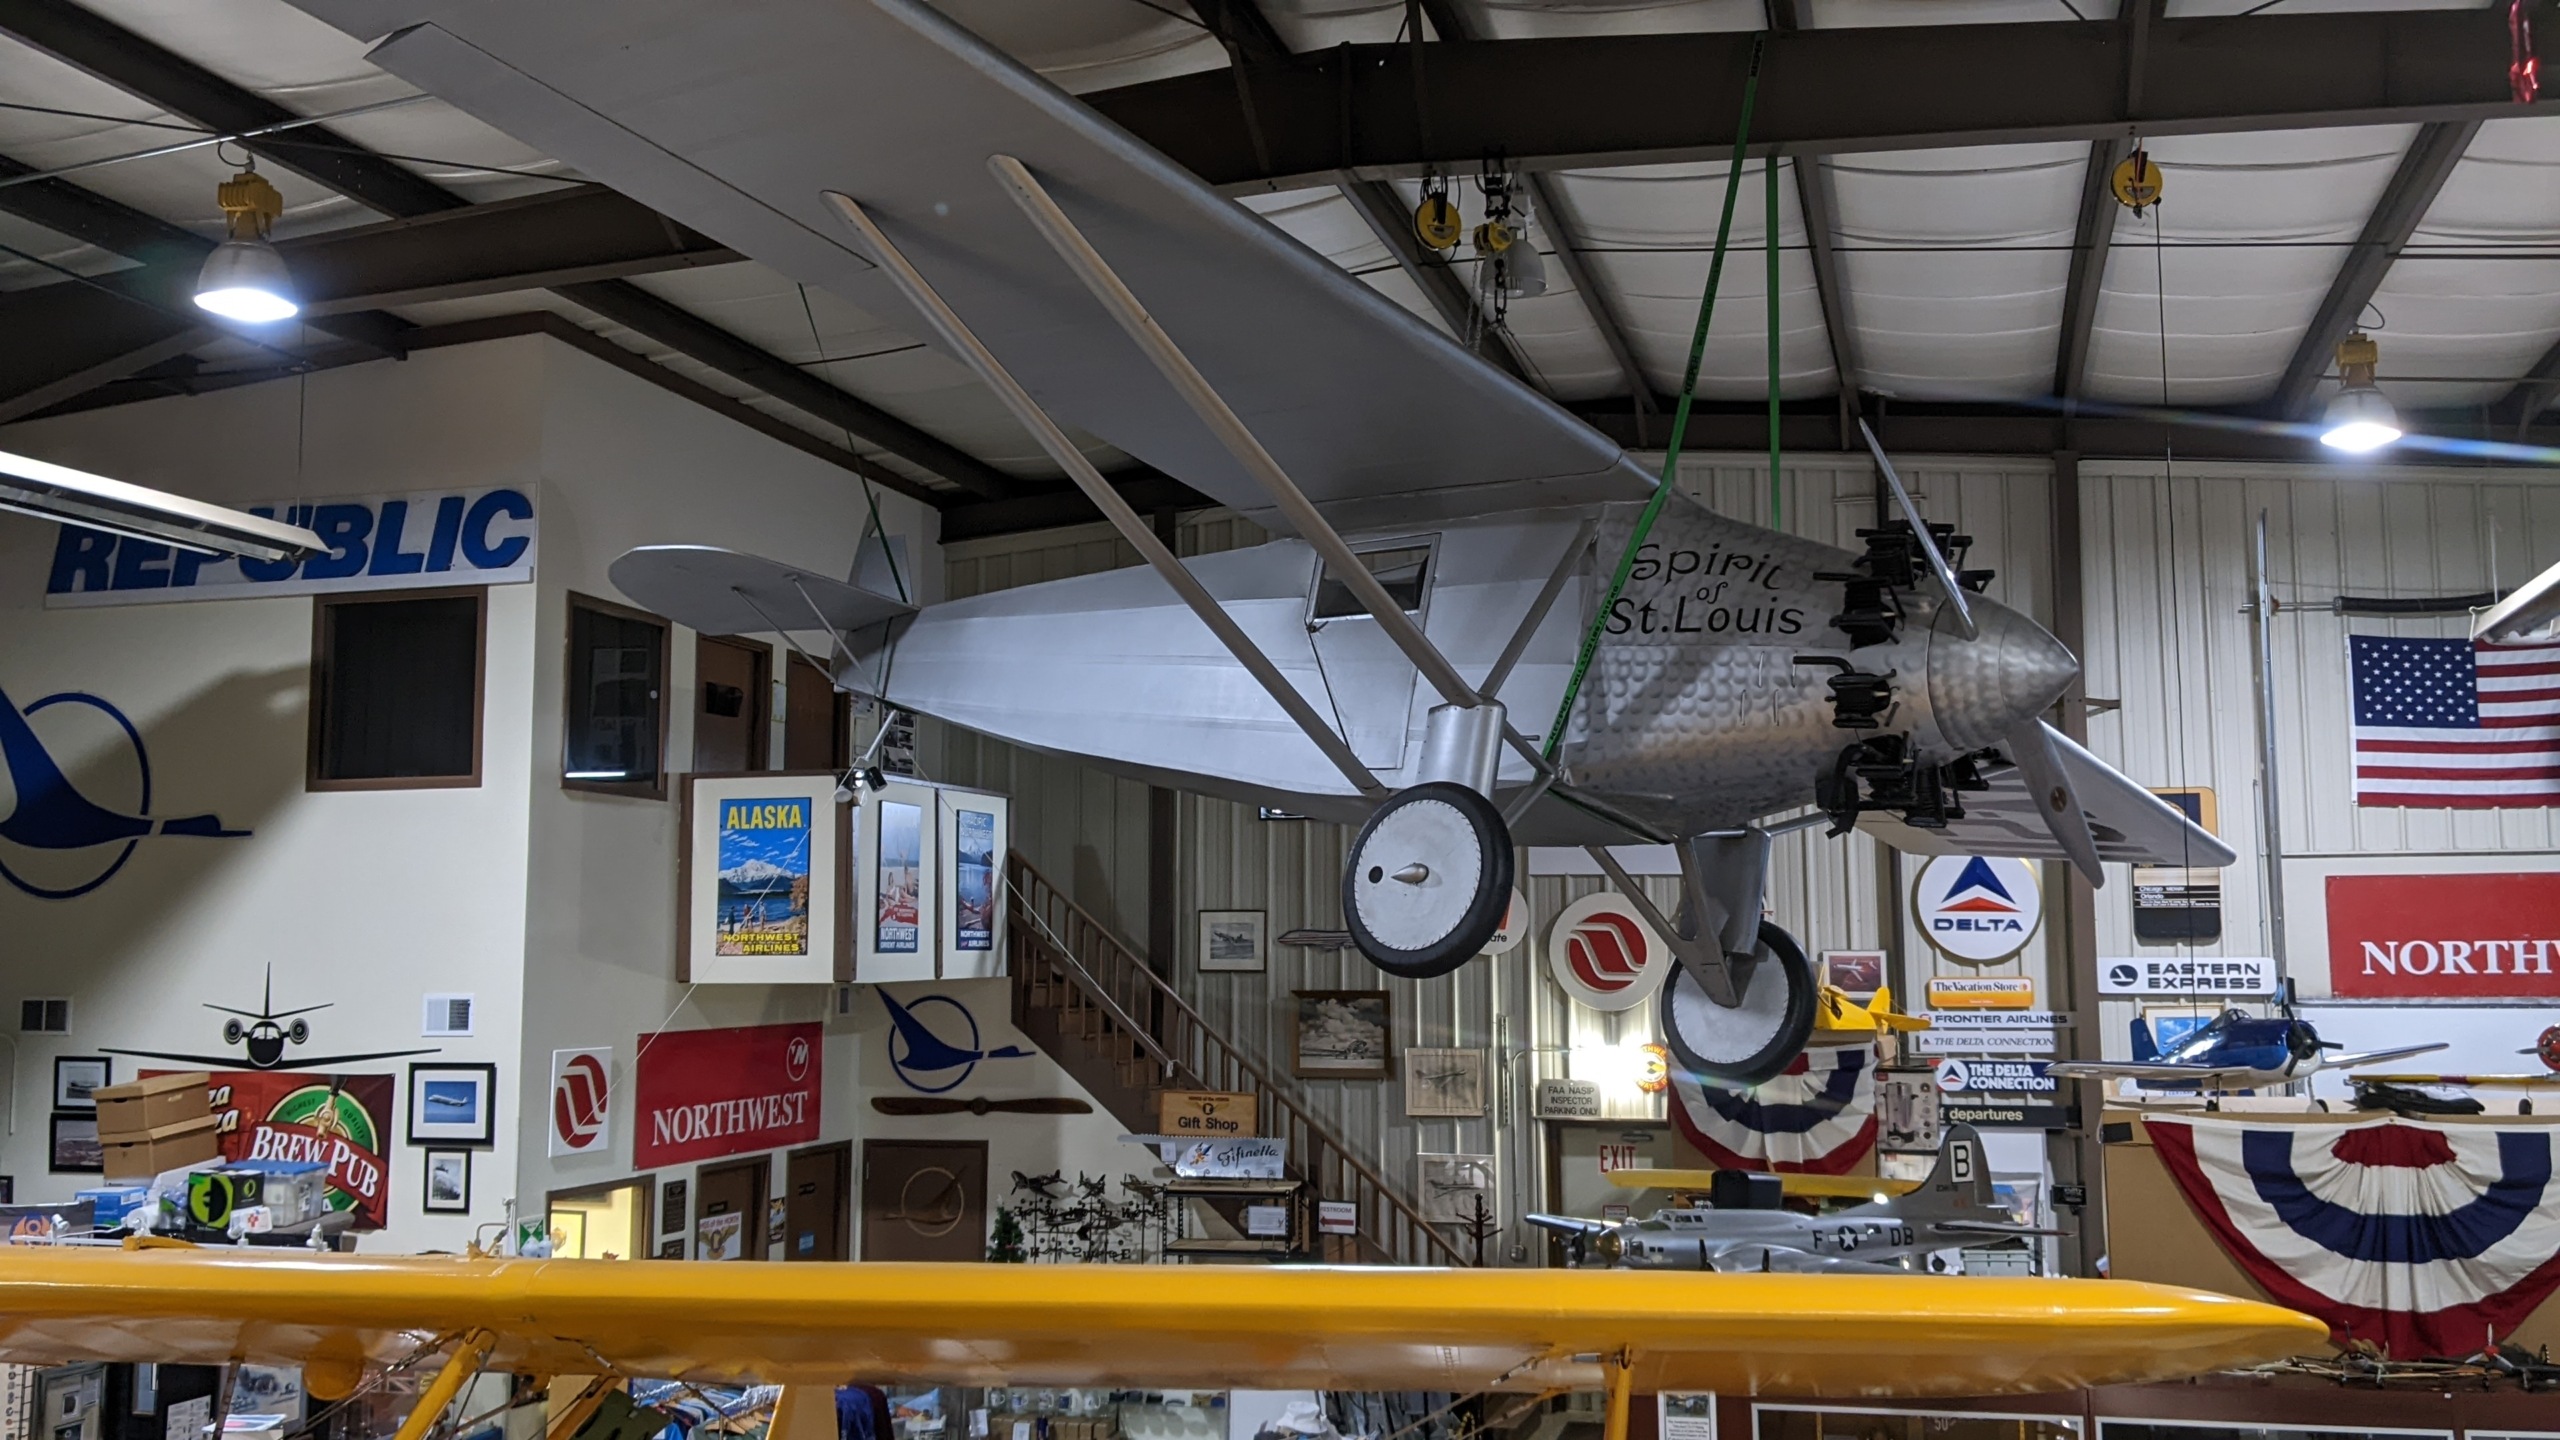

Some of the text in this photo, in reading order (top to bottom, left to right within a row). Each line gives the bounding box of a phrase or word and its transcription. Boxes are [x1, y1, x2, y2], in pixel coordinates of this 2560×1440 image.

[1630, 542, 1784, 590] Spirit
[1696, 581, 1728, 604] of
[727, 805, 802, 830] ALASKA
[1933, 918, 2023, 932] DELTA
[723, 932, 800, 942] NORTHWEST
[742, 943, 800, 953] AIRLINES
[2360, 939, 2560, 976] NORTH
[2147, 963, 2261, 975] EASTERN
[1993, 981, 2018, 992] Store
[2148, 977, 2262, 989] EXPRESS
[1935, 1015, 2068, 1024] FRONTIER AIRLINES
[1934, 1037, 2054, 1046] THE DELTA CONNECTION
[1969, 1063, 2034, 1077] THE DELTA
[1548, 1086, 1594, 1095] FAA NASIP
[1969, 1077, 2056, 1090] CONNECTION
[1550, 1096, 1593, 1105] INSPECTOR
[1544, 1106, 1599, 1116] PARKING ONLY
[1950, 1108, 2023, 1123] departures
[651, 1091, 809, 1146] NORTHWEST
[1177, 1116, 1239, 1133] Gift Shop
[248, 1126, 380, 1198] BREW PUB
[1600, 1145, 1636, 1174] EXIT
[1954, 1144, 1970, 1178] B
[1320, 1206, 1352, 1214] RESTROOM
[1812, 1227, 1914, 1249] F DB
